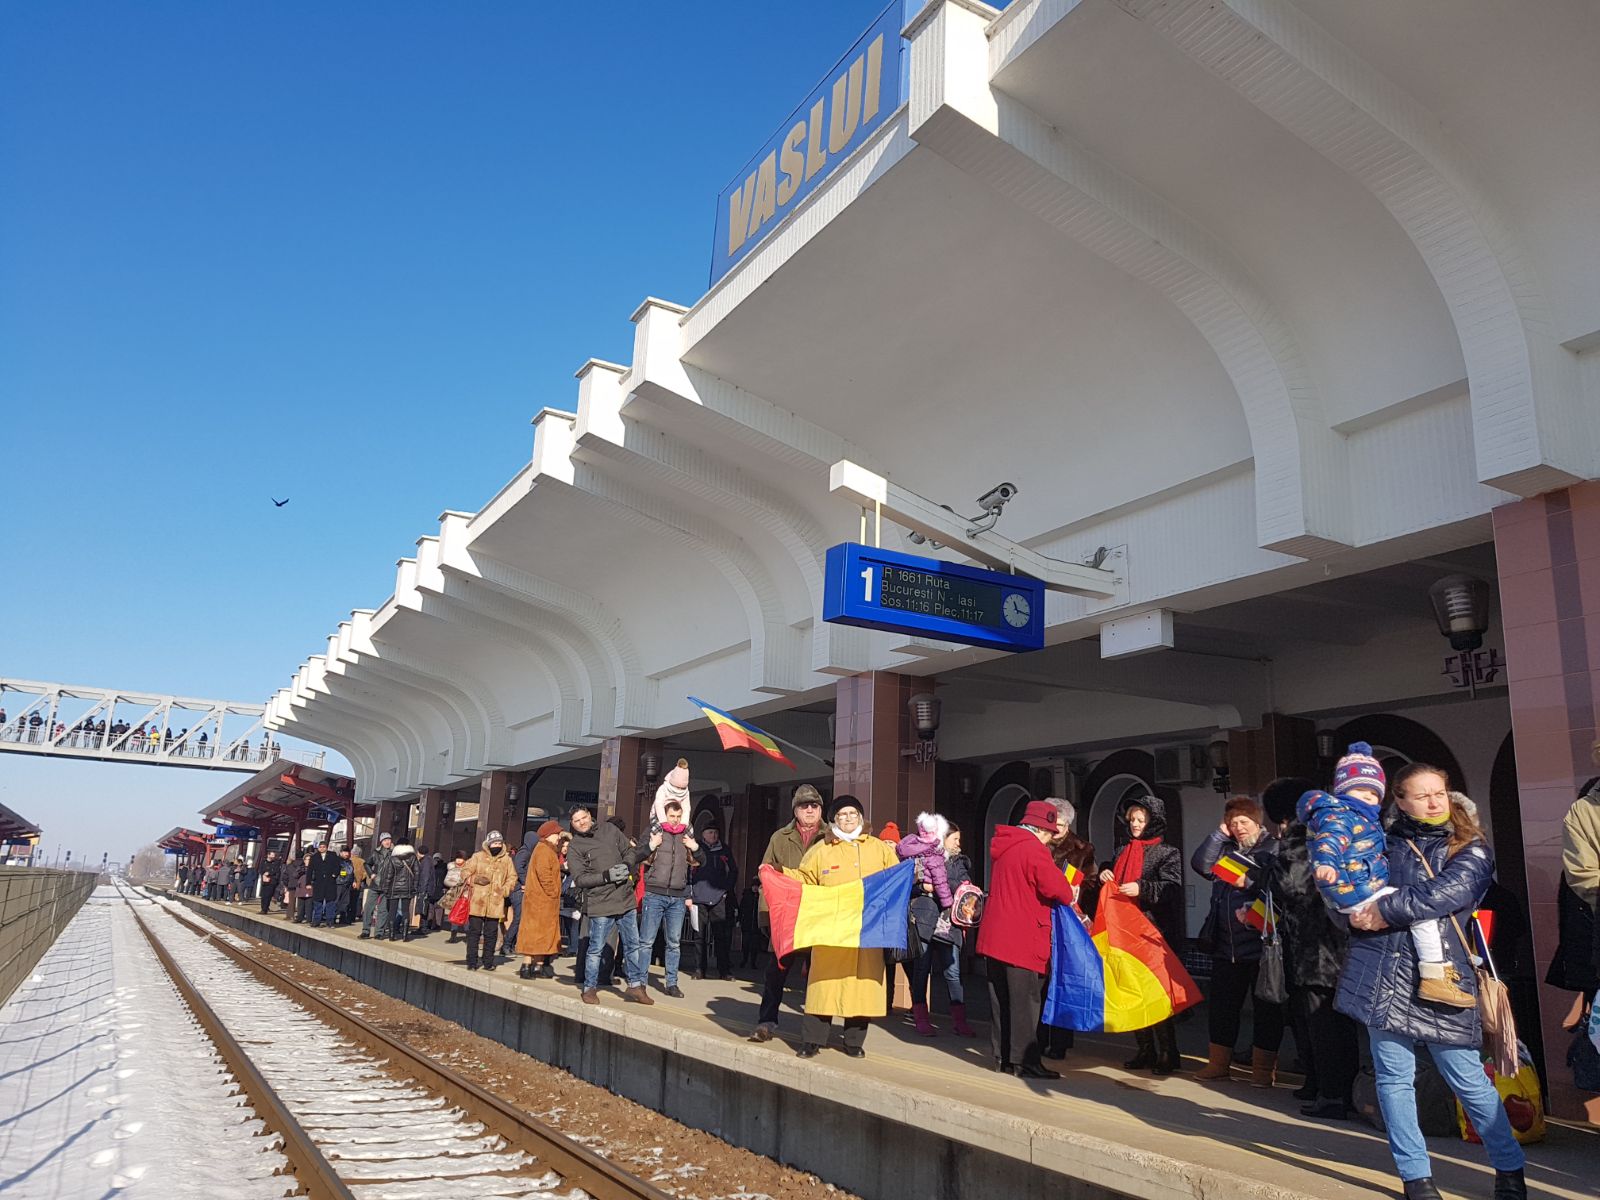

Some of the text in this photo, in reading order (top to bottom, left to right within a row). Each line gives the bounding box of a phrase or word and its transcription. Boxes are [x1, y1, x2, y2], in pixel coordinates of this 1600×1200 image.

[728, 33, 883, 257] VASLUI
[861, 567, 873, 602] 1
[884, 567, 950, 589] R 1661 Ruta
[881, 580, 933, 599] Bucuresti
[937, 591, 946, 601] N
[881, 594, 930, 612] Sos.11:16
